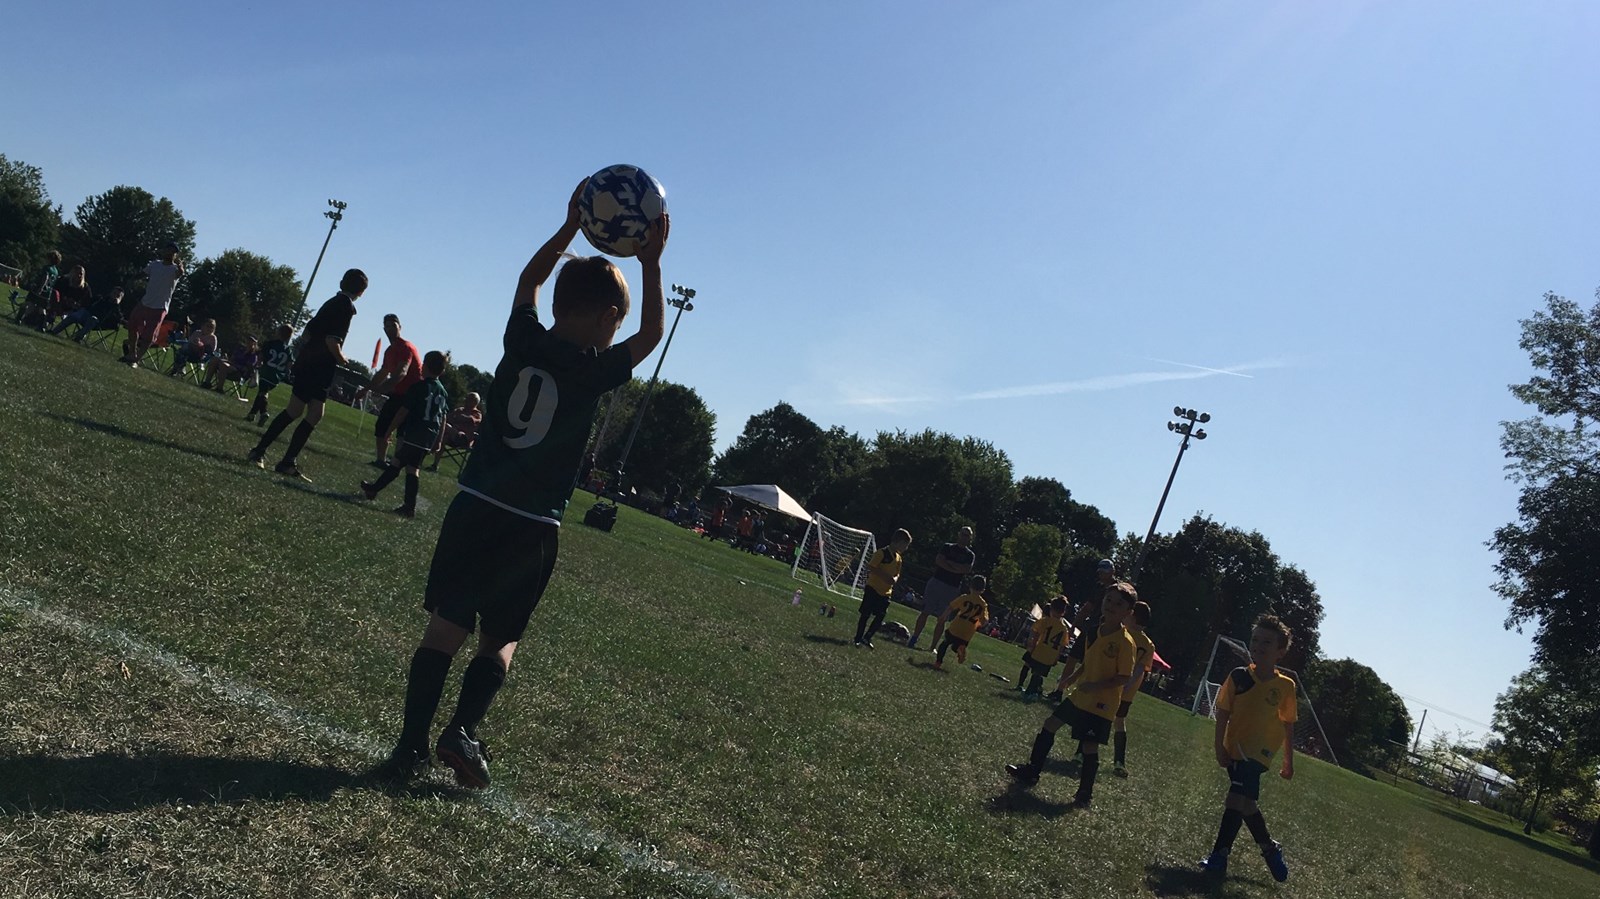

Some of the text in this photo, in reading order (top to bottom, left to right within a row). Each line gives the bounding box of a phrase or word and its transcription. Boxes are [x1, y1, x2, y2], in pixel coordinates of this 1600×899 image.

[267, 349, 288, 371] 22
[502, 366, 558, 449] 9
[960, 601, 983, 621] 22
[1043, 626, 1063, 649] 14
